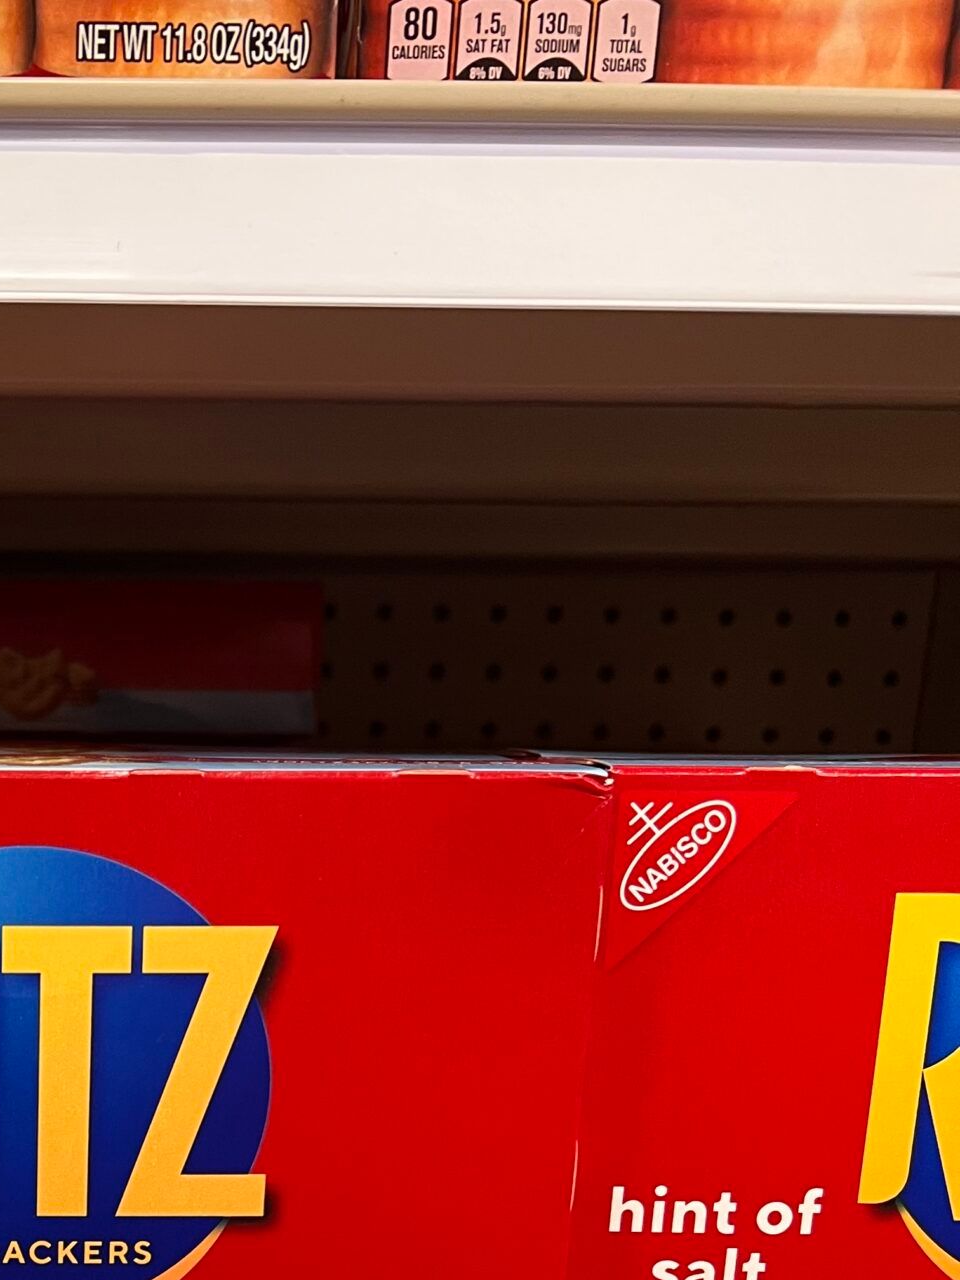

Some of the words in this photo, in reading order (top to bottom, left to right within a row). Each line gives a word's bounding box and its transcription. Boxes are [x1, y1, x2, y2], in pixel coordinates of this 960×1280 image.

[404, 7, 438, 41] 80
[77, 22, 120, 61] NET
[122, 23, 157, 61] WT
[162, 23, 206, 62] 11.8
[211, 23, 241, 62] OZ
[244, 20, 310, 71] (334g)
[392, 45, 445, 60] CALORIES
[466, 39, 486, 53] SAT
[491, 39, 510, 53] FAT
[535, 39, 580, 54] SODIUM
[609, 40, 642, 54] TOTAL
[602, 58, 647, 72] SUGARS
[627, 808, 727, 904] NABISCO
[608, 1186, 738, 1235] hint
[755, 1188, 824, 1235] of
